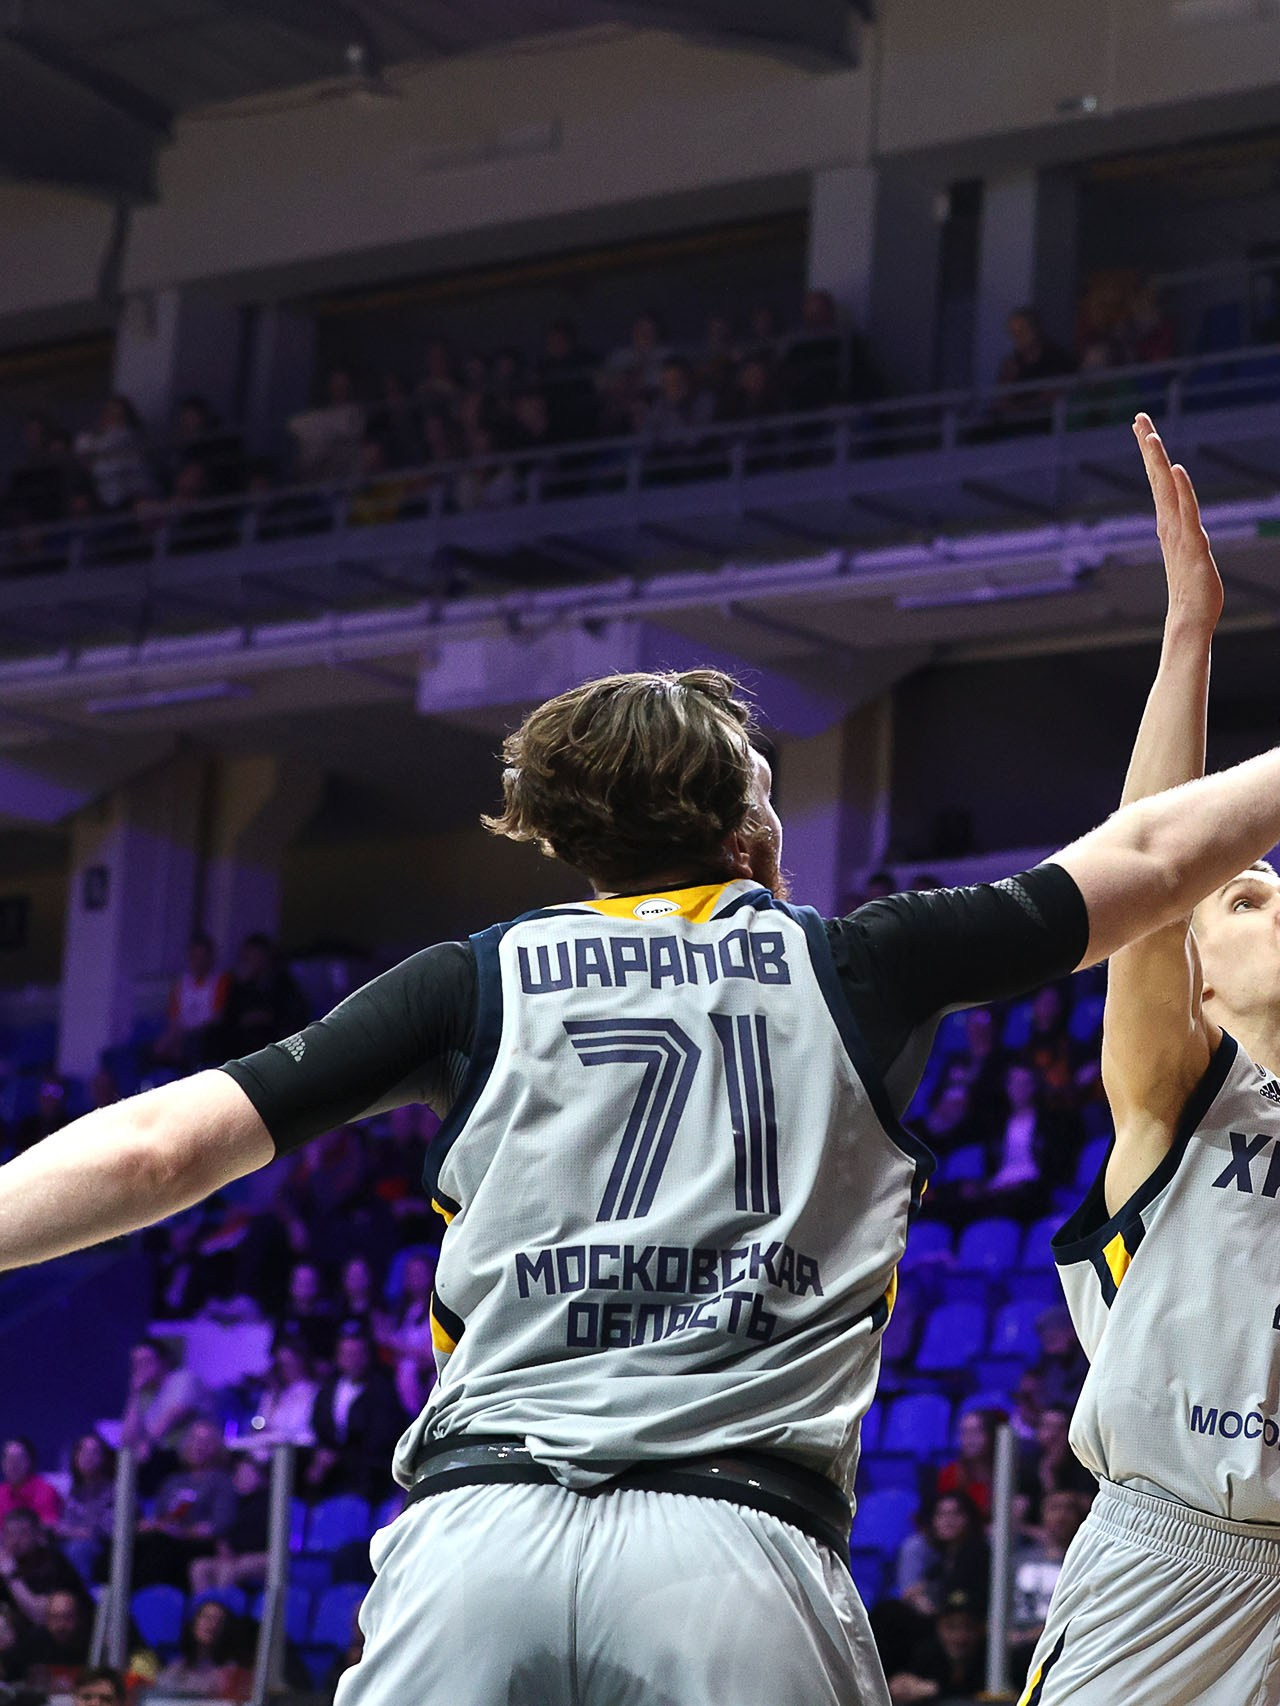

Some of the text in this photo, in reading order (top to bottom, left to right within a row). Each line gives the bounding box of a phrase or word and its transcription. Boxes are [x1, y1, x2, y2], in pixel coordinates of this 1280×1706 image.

[516, 928, 791, 995] ШАРАПОВ
[562, 1012, 781, 1222] 71
[514, 1242, 824, 1298] МОСКОВСКАЯ
[566, 1291, 778, 1348] ОБЛАСТЬ
